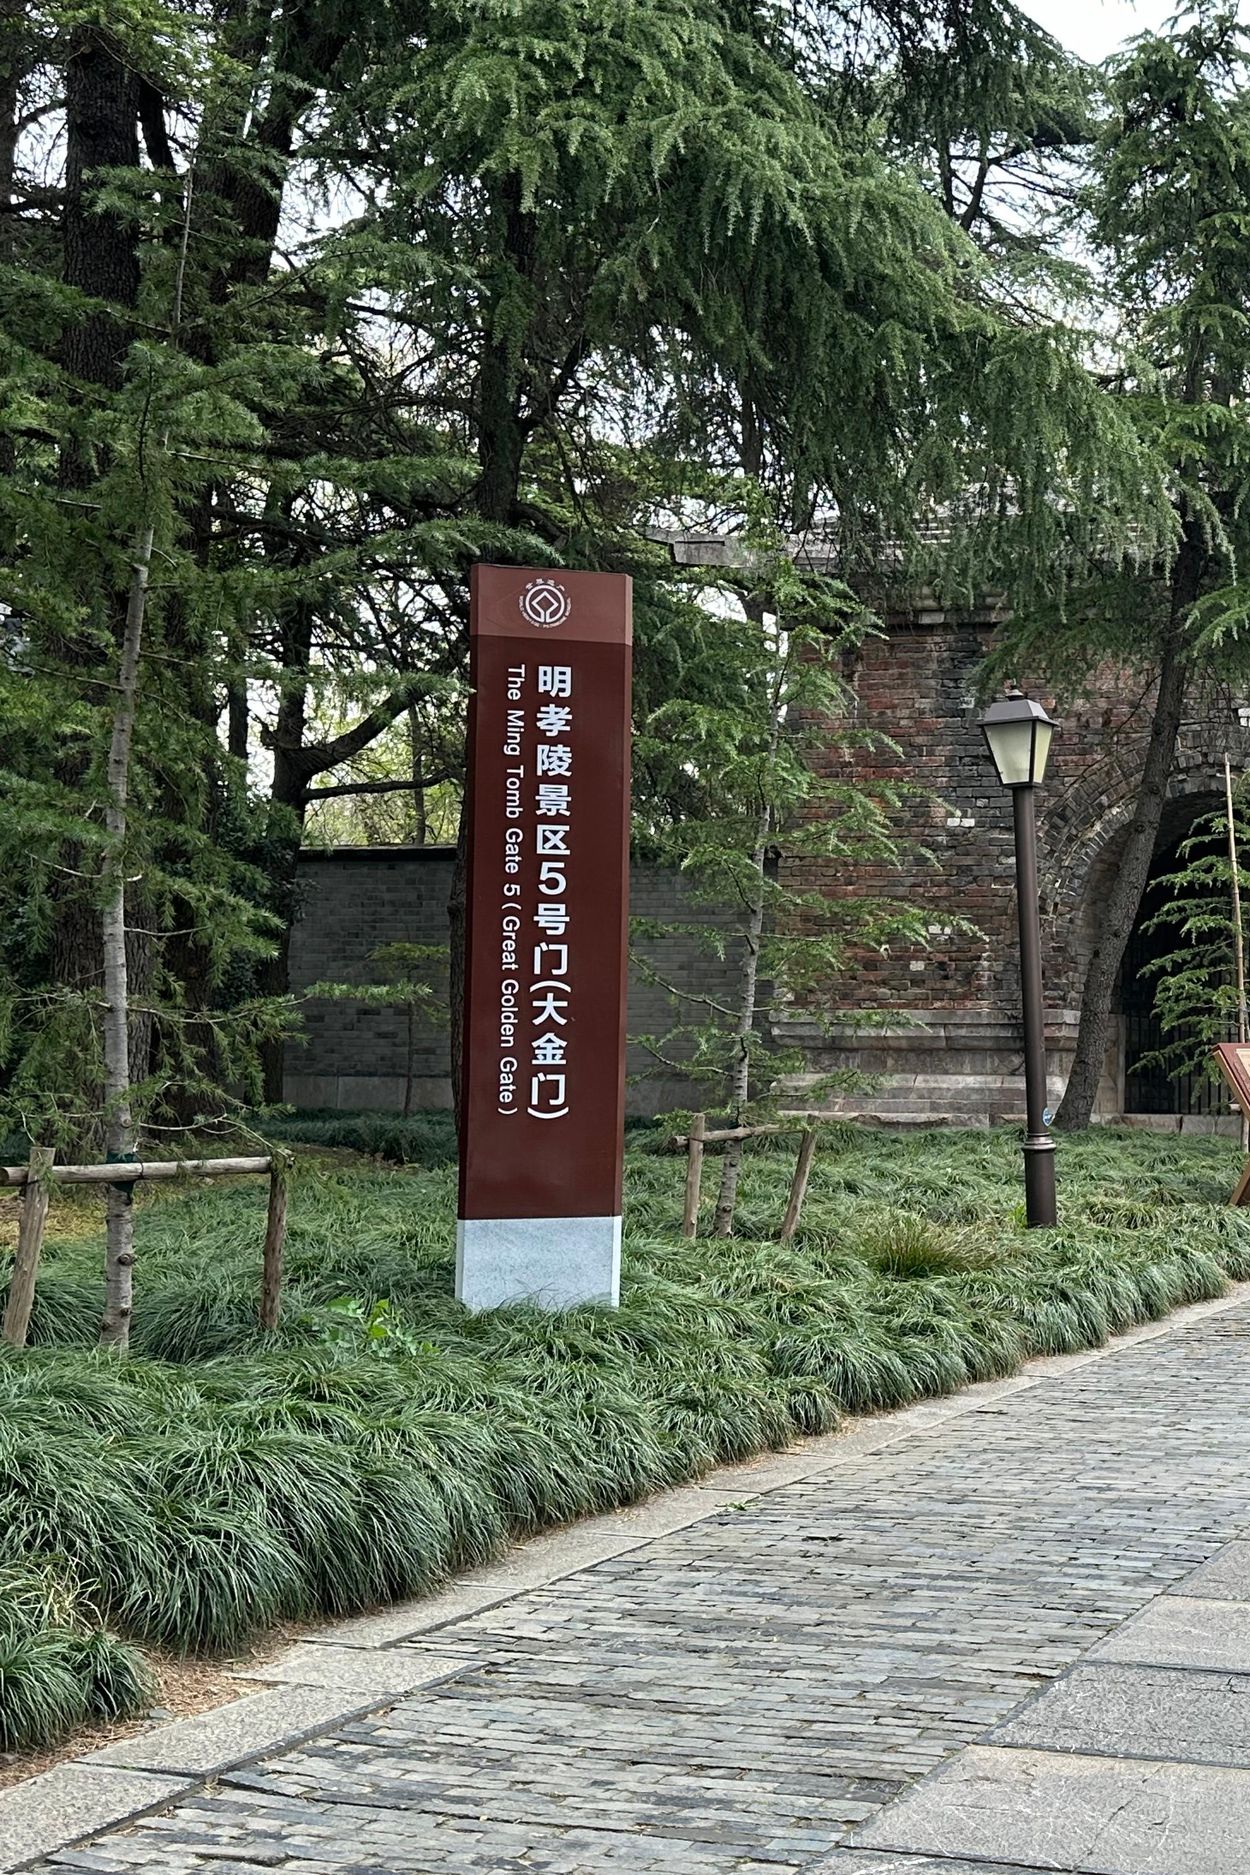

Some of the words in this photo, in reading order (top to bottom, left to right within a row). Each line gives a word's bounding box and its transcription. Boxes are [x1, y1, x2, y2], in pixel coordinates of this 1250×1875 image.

[507, 664, 526, 700] The
[504, 710, 525, 756] Ming
[505, 765, 524, 819] Tomb
[504, 828, 524, 874] Gate
[503, 883, 521, 896] 5
[500, 979, 519, 1048] Golden
[498, 1057, 518, 1115] Gate)
